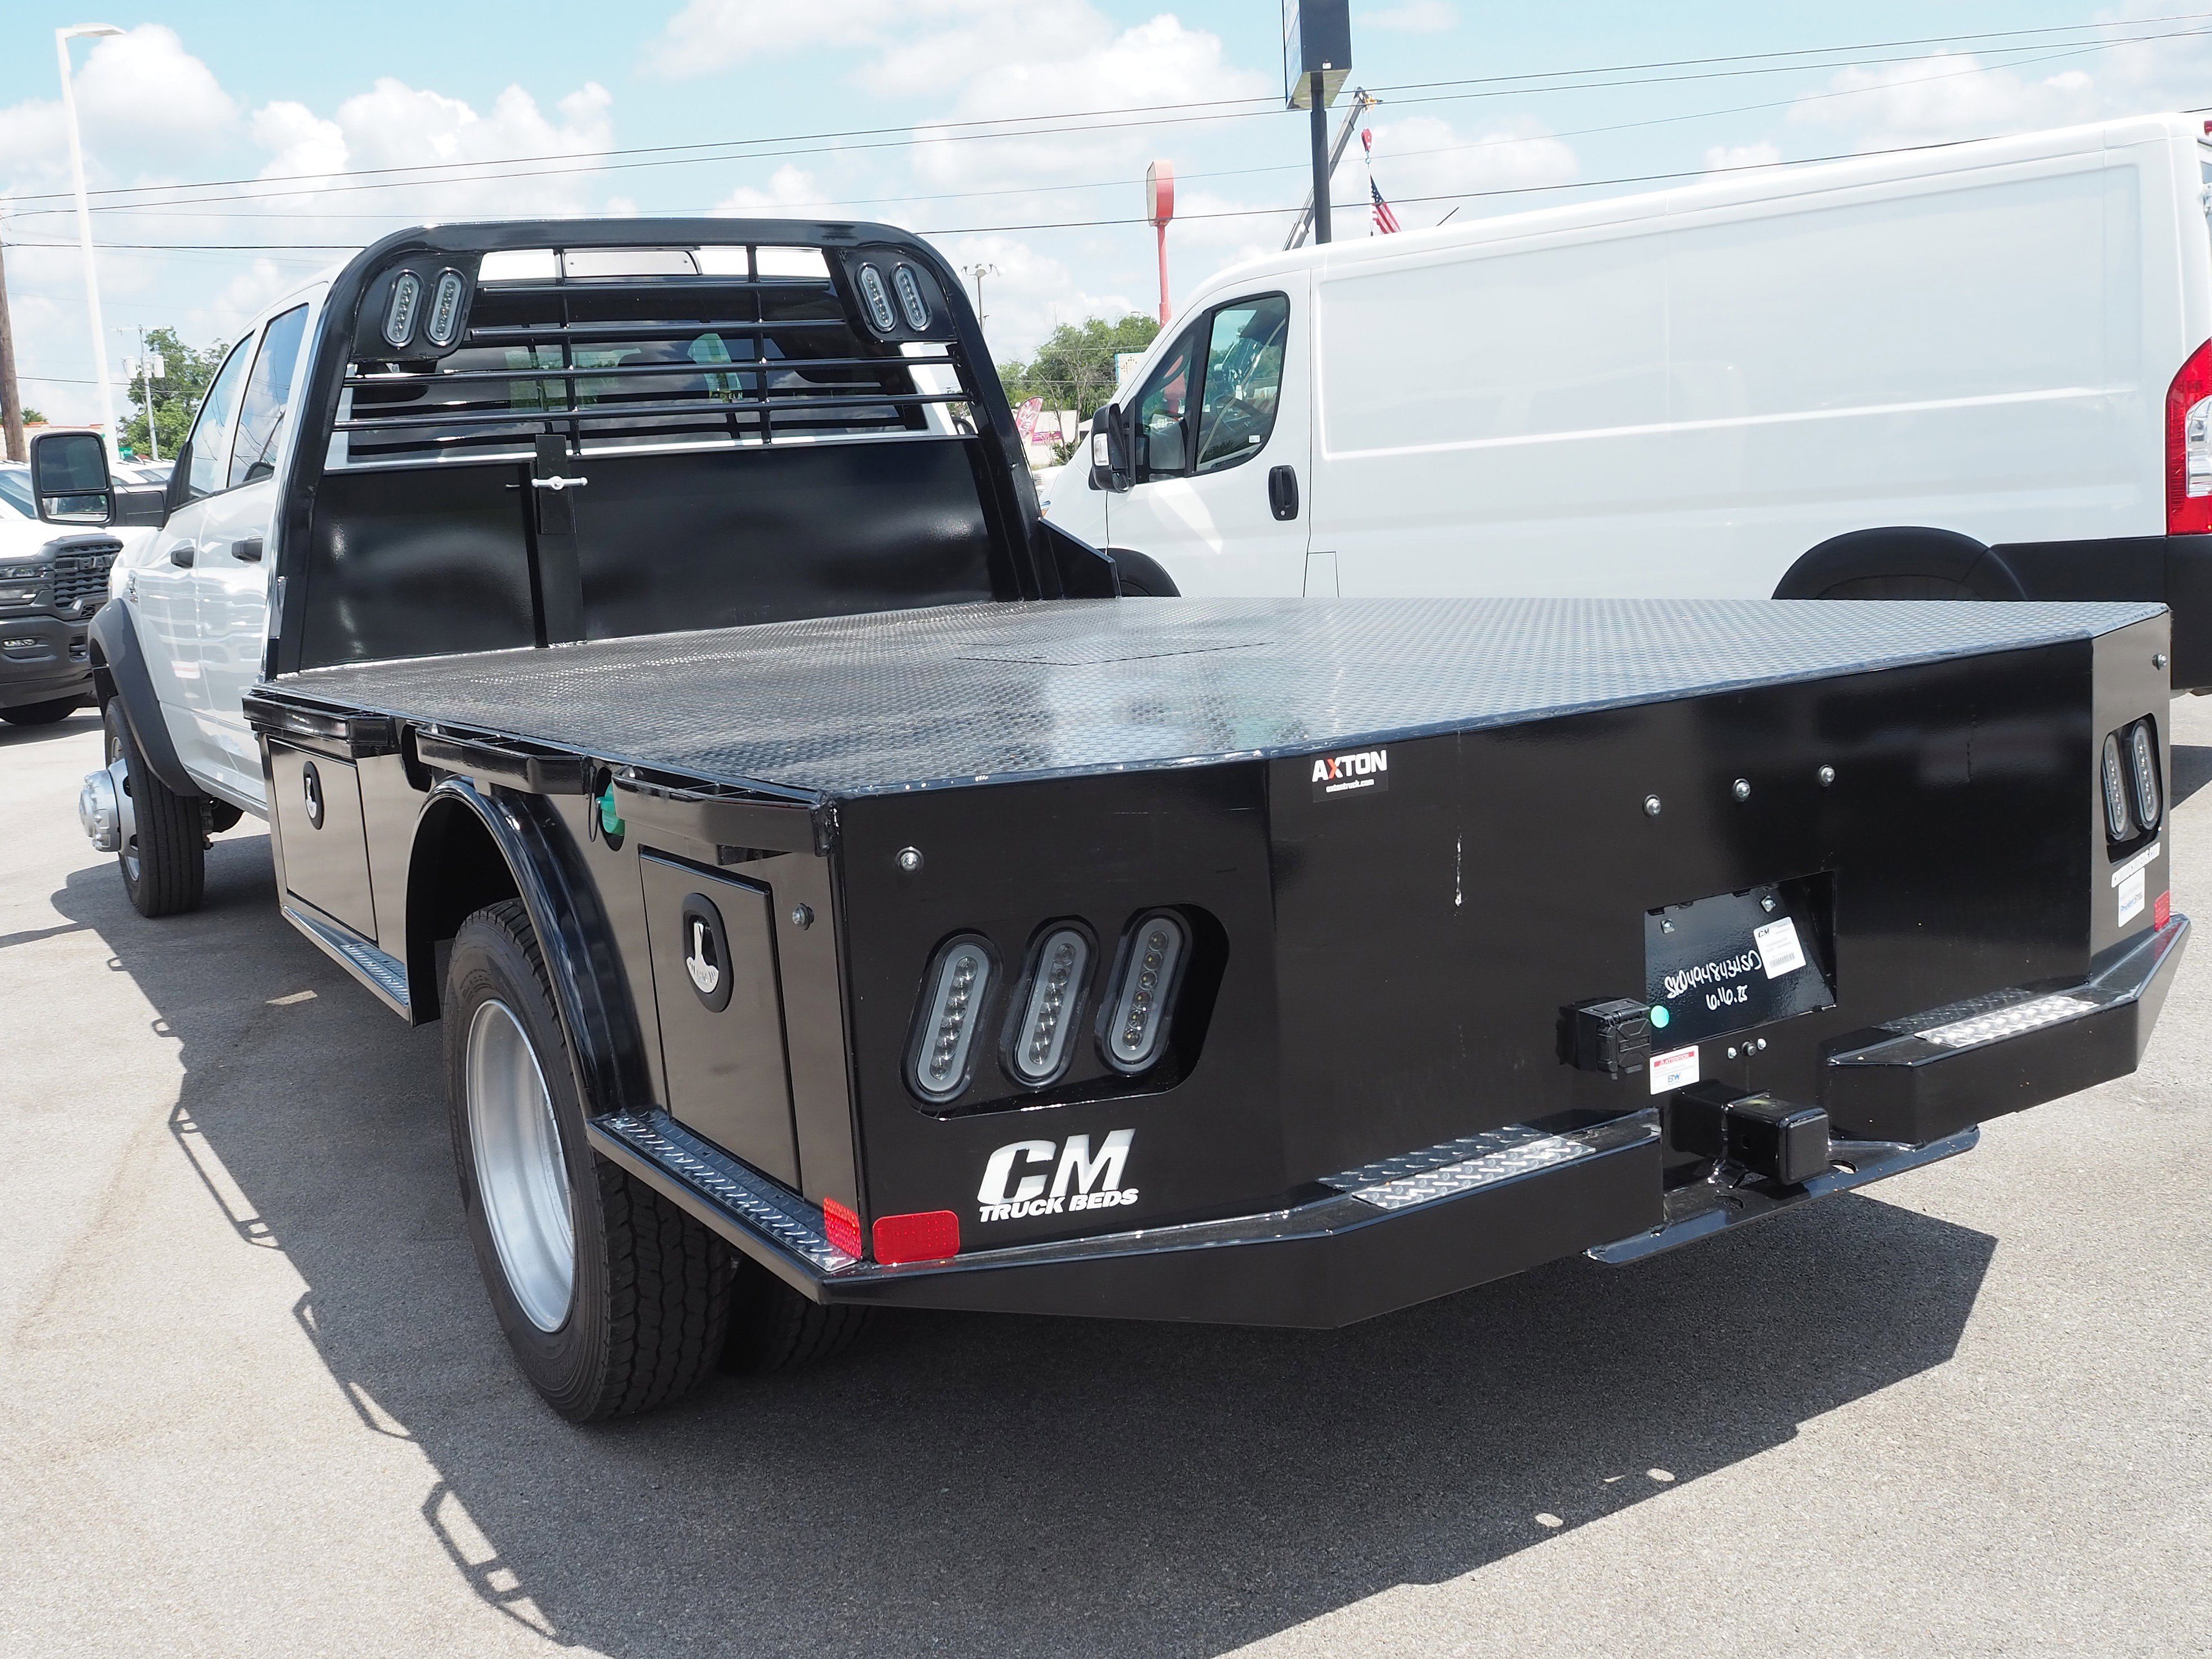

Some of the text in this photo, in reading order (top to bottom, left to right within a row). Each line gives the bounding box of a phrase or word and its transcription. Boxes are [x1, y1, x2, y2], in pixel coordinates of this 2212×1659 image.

[1312, 749, 1388, 783] AXTON
[977, 1128, 1136, 1205] CM
[979, 1188, 1139, 1222] TRUCK BEDS
